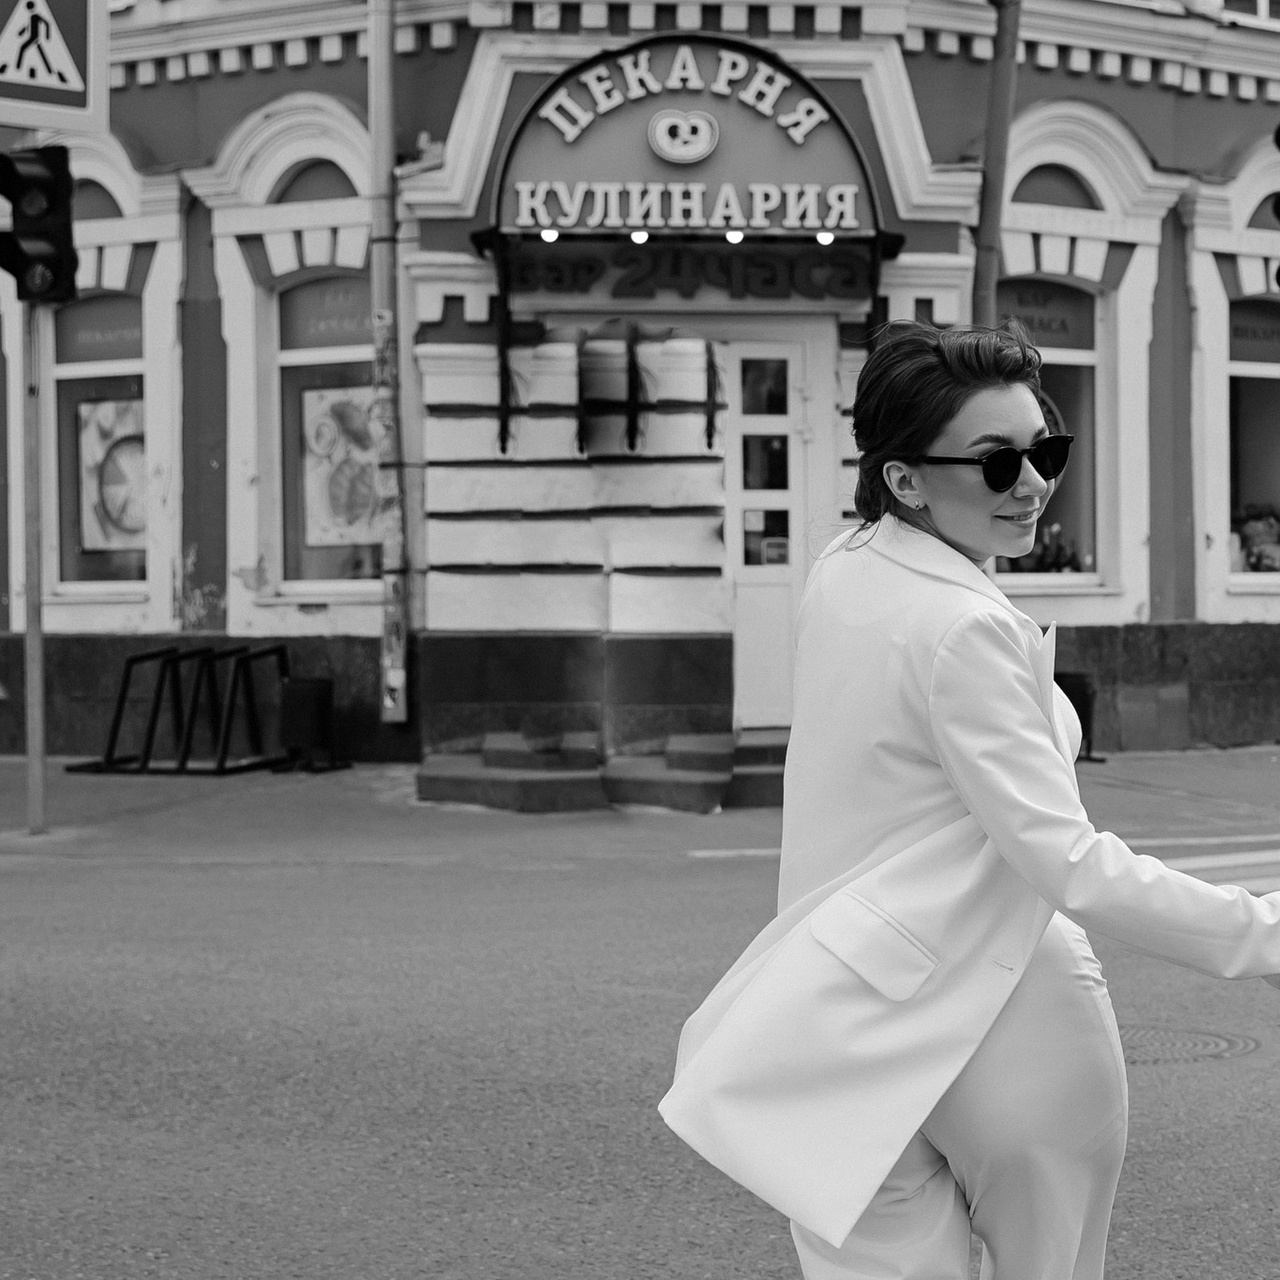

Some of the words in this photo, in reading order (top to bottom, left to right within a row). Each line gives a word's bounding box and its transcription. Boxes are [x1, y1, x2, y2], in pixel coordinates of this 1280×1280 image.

[538, 44, 830, 144] ПЕКАРНЯ
[515, 181, 859, 229] КУЛИНАРИЯ
[609, 246, 701, 298] 24
